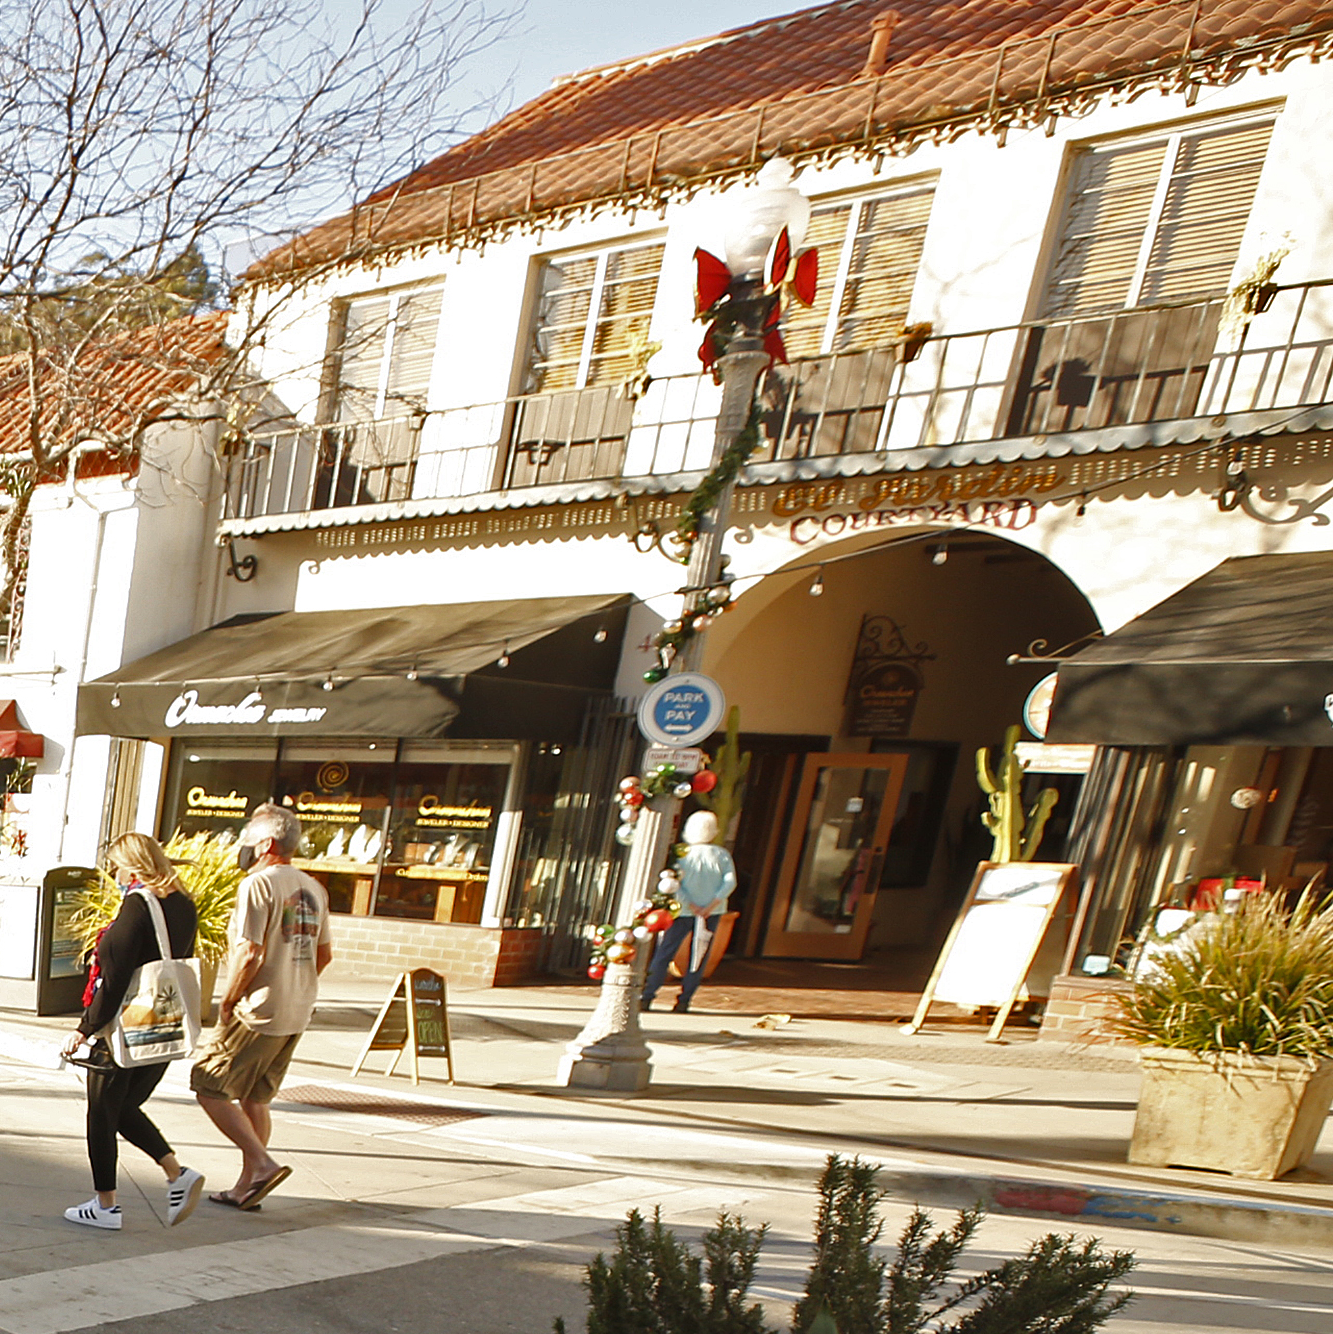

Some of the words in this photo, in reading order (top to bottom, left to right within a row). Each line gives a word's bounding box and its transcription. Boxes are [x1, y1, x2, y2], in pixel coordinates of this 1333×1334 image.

[790, 498, 1037, 545] COURTYARD
[664, 692, 704, 703] PARK
[664, 710, 696, 721] PAY
[418, 1020, 444, 1043] OPEN
